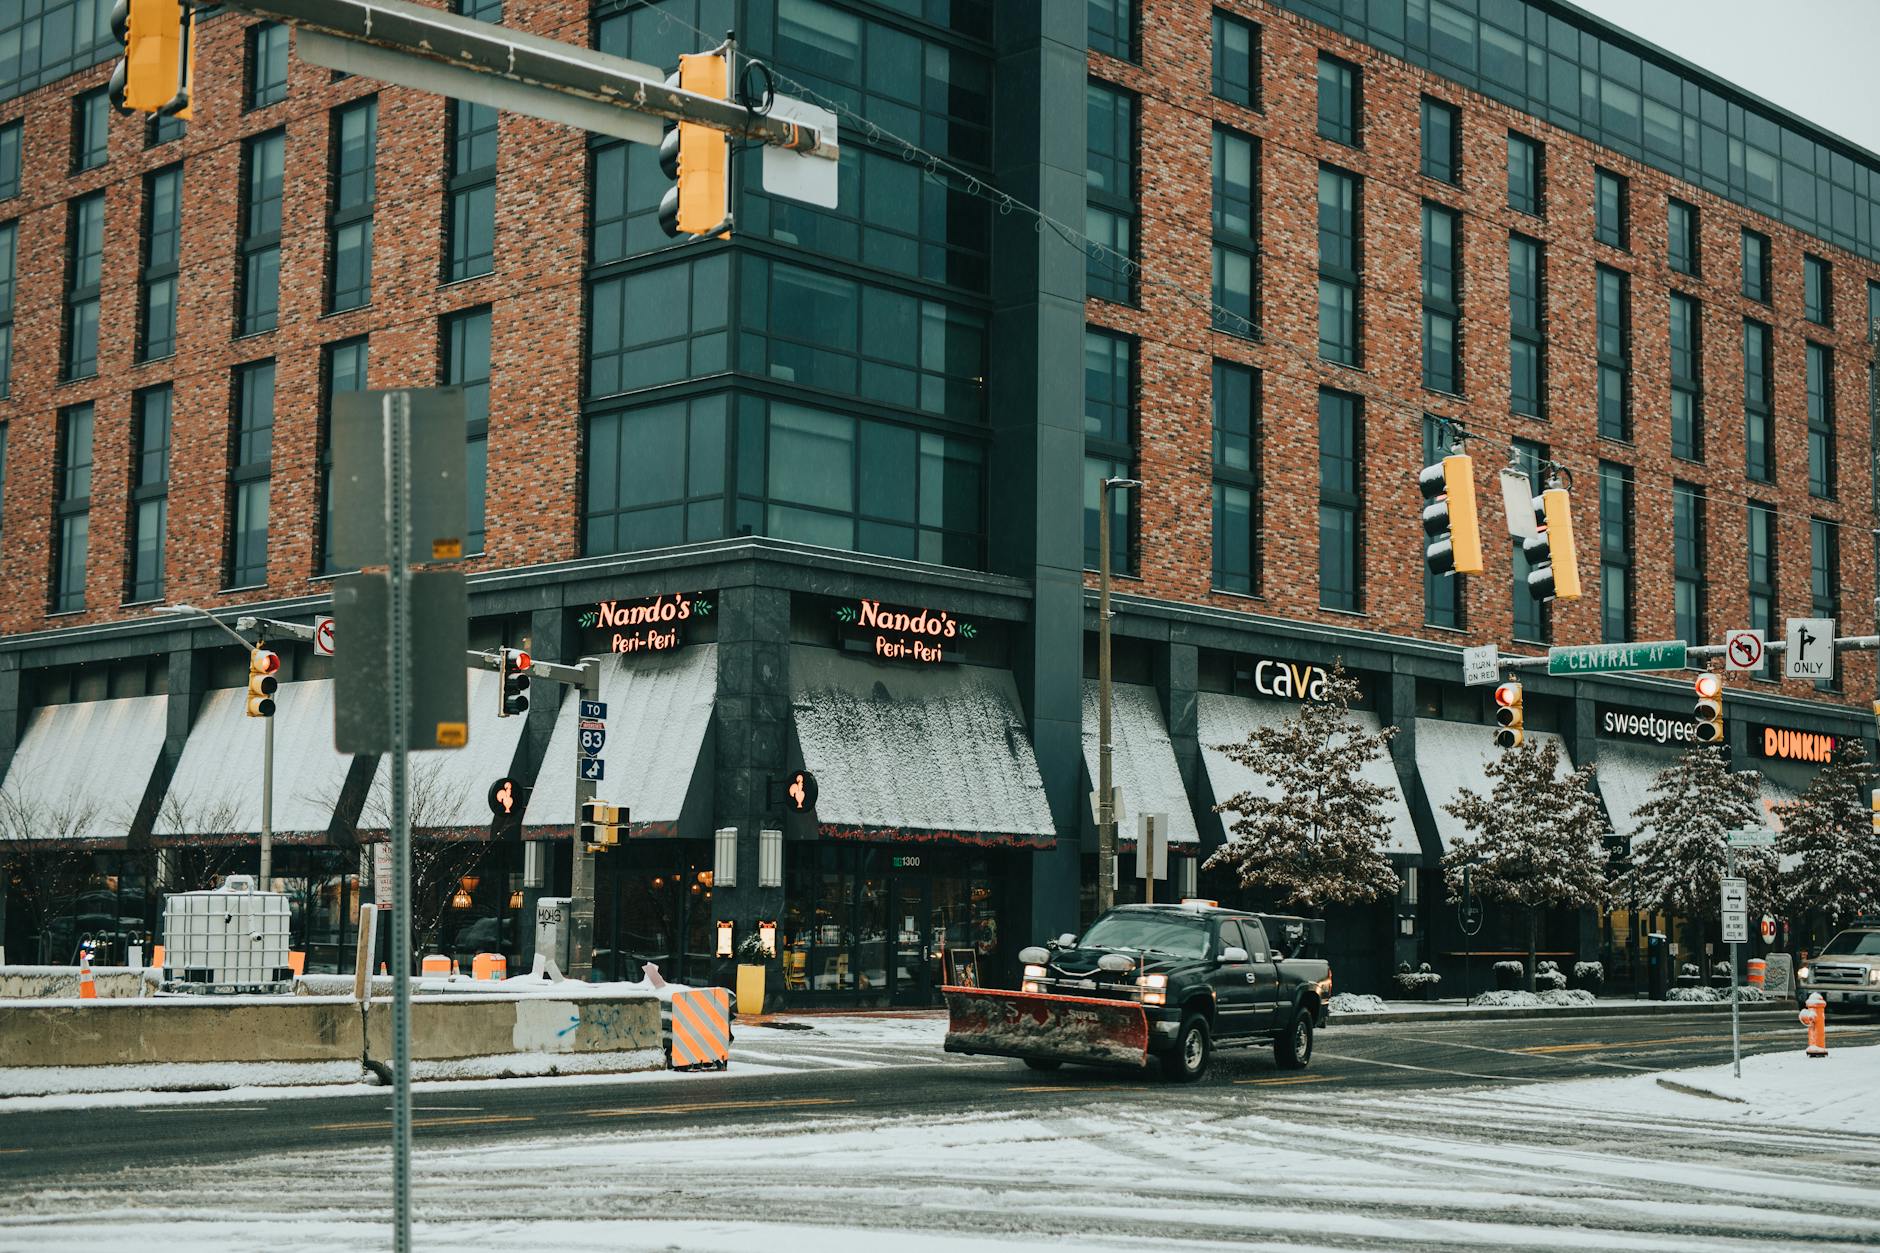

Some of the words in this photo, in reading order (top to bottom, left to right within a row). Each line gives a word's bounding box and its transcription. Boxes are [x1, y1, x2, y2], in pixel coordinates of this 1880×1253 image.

[597, 594, 691, 628] Nando's
[857, 599, 956, 638] Nando's
[612, 628, 675, 653] Peri-Peri
[876, 635, 942, 662] Peri-Peri
[1474, 650, 1487, 658] NO
[1569, 647, 1639, 669] CENTRAL
[1649, 647, 1664, 662] AV
[1472, 661, 1491, 670] TURN
[1793, 662, 1823, 674] ONLY
[1468, 673, 1478, 681] ON
[1481, 671, 1495, 679] RED
[587, 704, 600, 716] TO
[1605, 711, 1697, 743] sweetgree
[582, 731, 602, 748] 83
[902, 856, 920, 867] 1300
